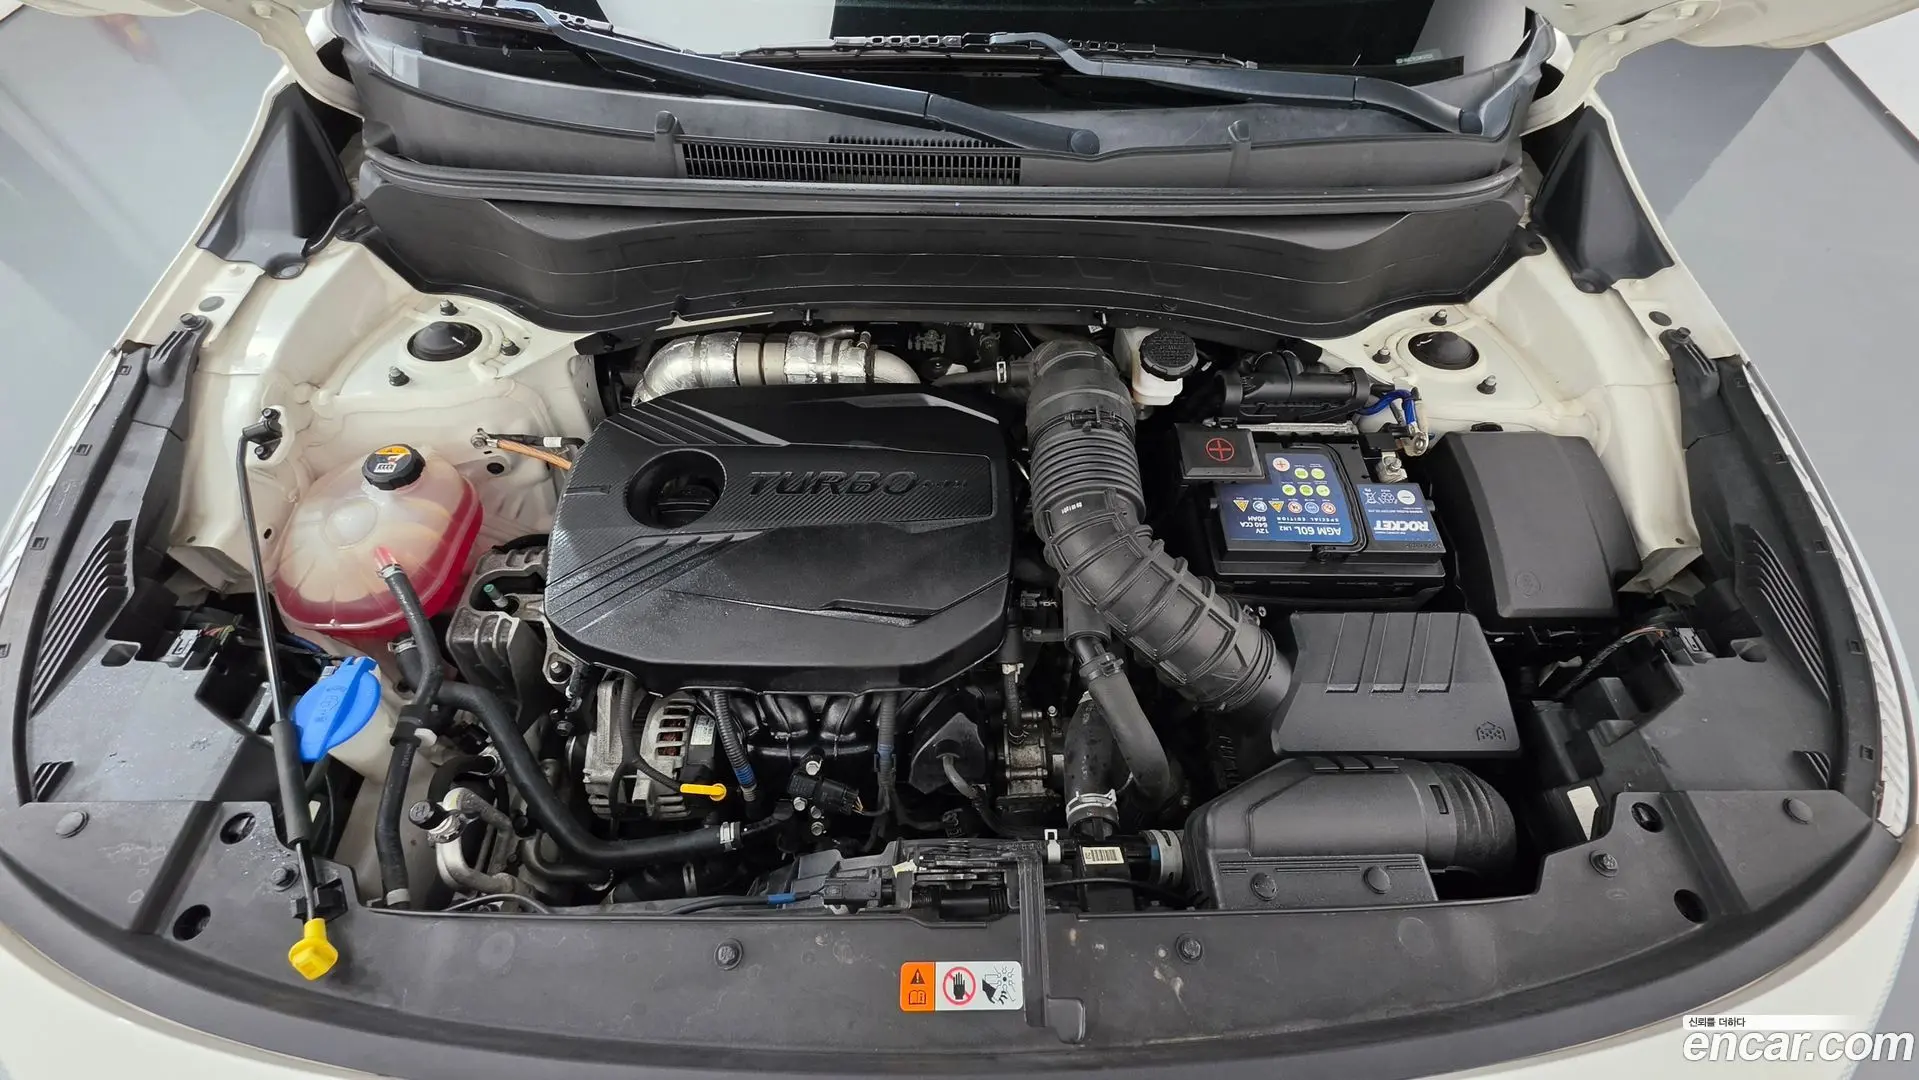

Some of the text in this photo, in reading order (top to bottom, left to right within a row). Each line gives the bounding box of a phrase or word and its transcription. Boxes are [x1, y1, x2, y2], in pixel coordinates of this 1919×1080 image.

[750, 471, 918, 497] TURBO
[1373, 520, 1430, 531] ROCKET
[1294, 526, 1315, 536] 60L
[1317, 526, 1342, 536] AGM
